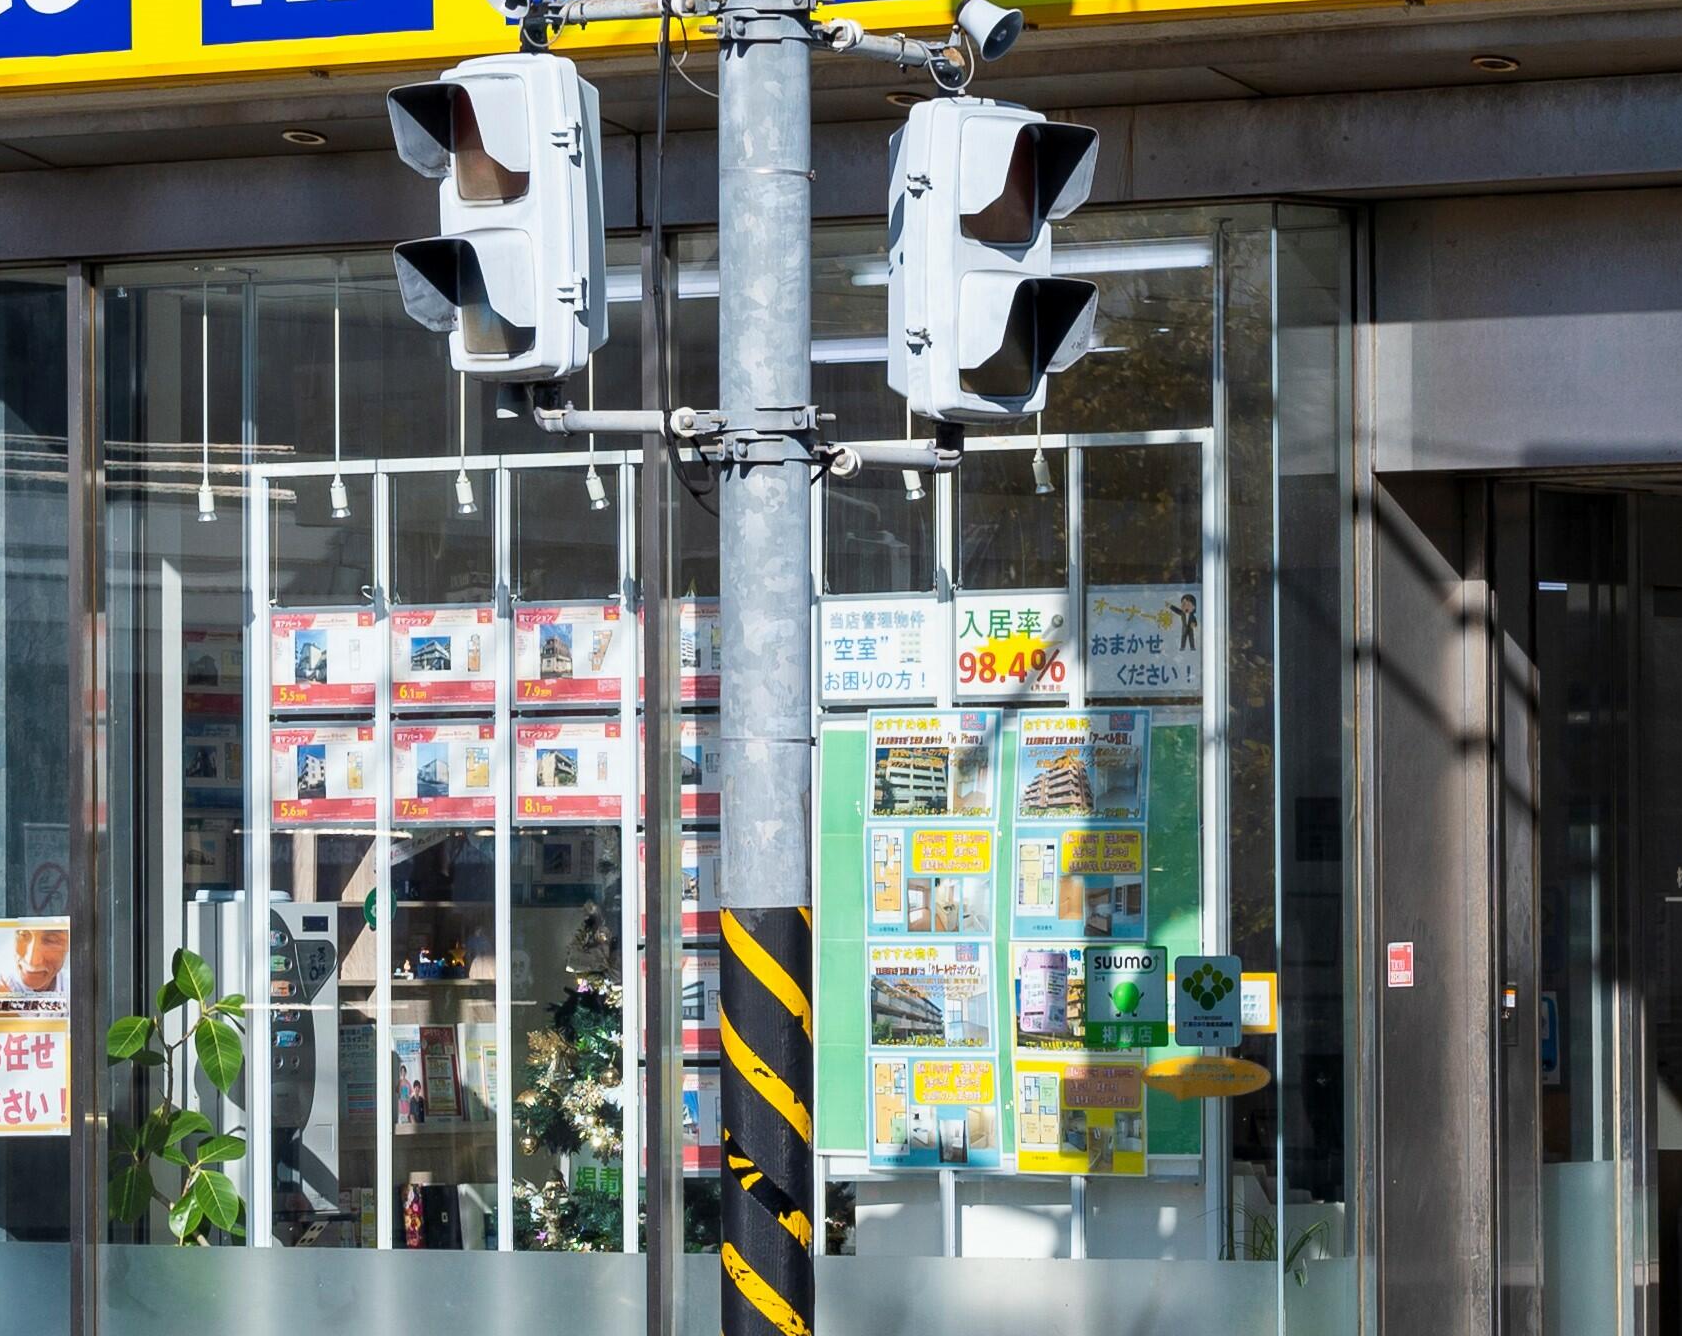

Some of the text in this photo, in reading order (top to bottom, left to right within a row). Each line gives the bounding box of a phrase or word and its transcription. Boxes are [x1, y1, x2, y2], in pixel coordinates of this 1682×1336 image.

[830, 610, 925, 629] 当店管理物件
[959, 609, 1042, 639] 入居率
[1091, 633, 1164, 656] おまかせ
[959, 648, 1066, 684] 98.4%
[1102, 1025, 1153, 1044] 掲載店
